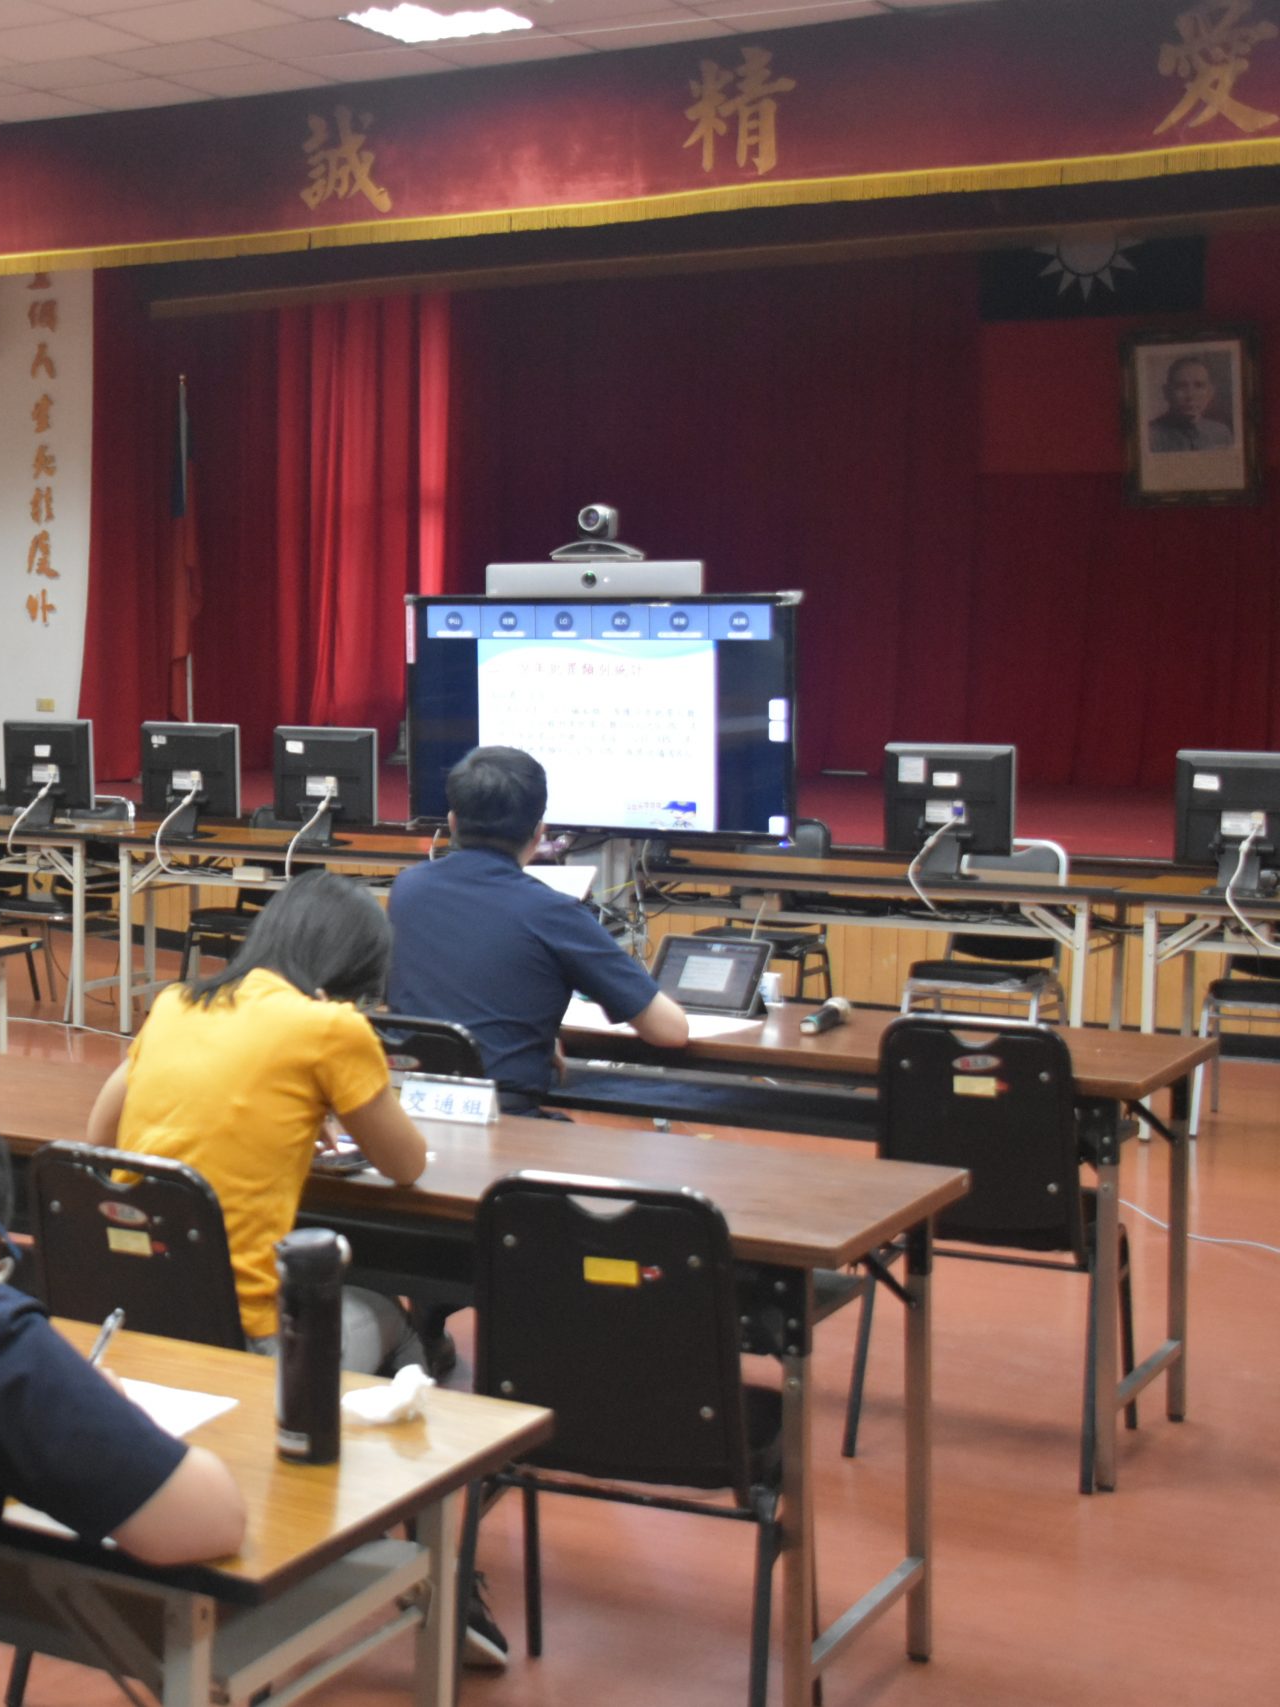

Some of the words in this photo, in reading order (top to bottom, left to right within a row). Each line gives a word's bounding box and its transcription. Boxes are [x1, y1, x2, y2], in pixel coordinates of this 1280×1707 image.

[682, 46, 796, 175] 精
[1152, 0, 1280, 135] 愛
[300, 103, 393, 213] 誠
[406, 1089, 483, 1116] 交通組
